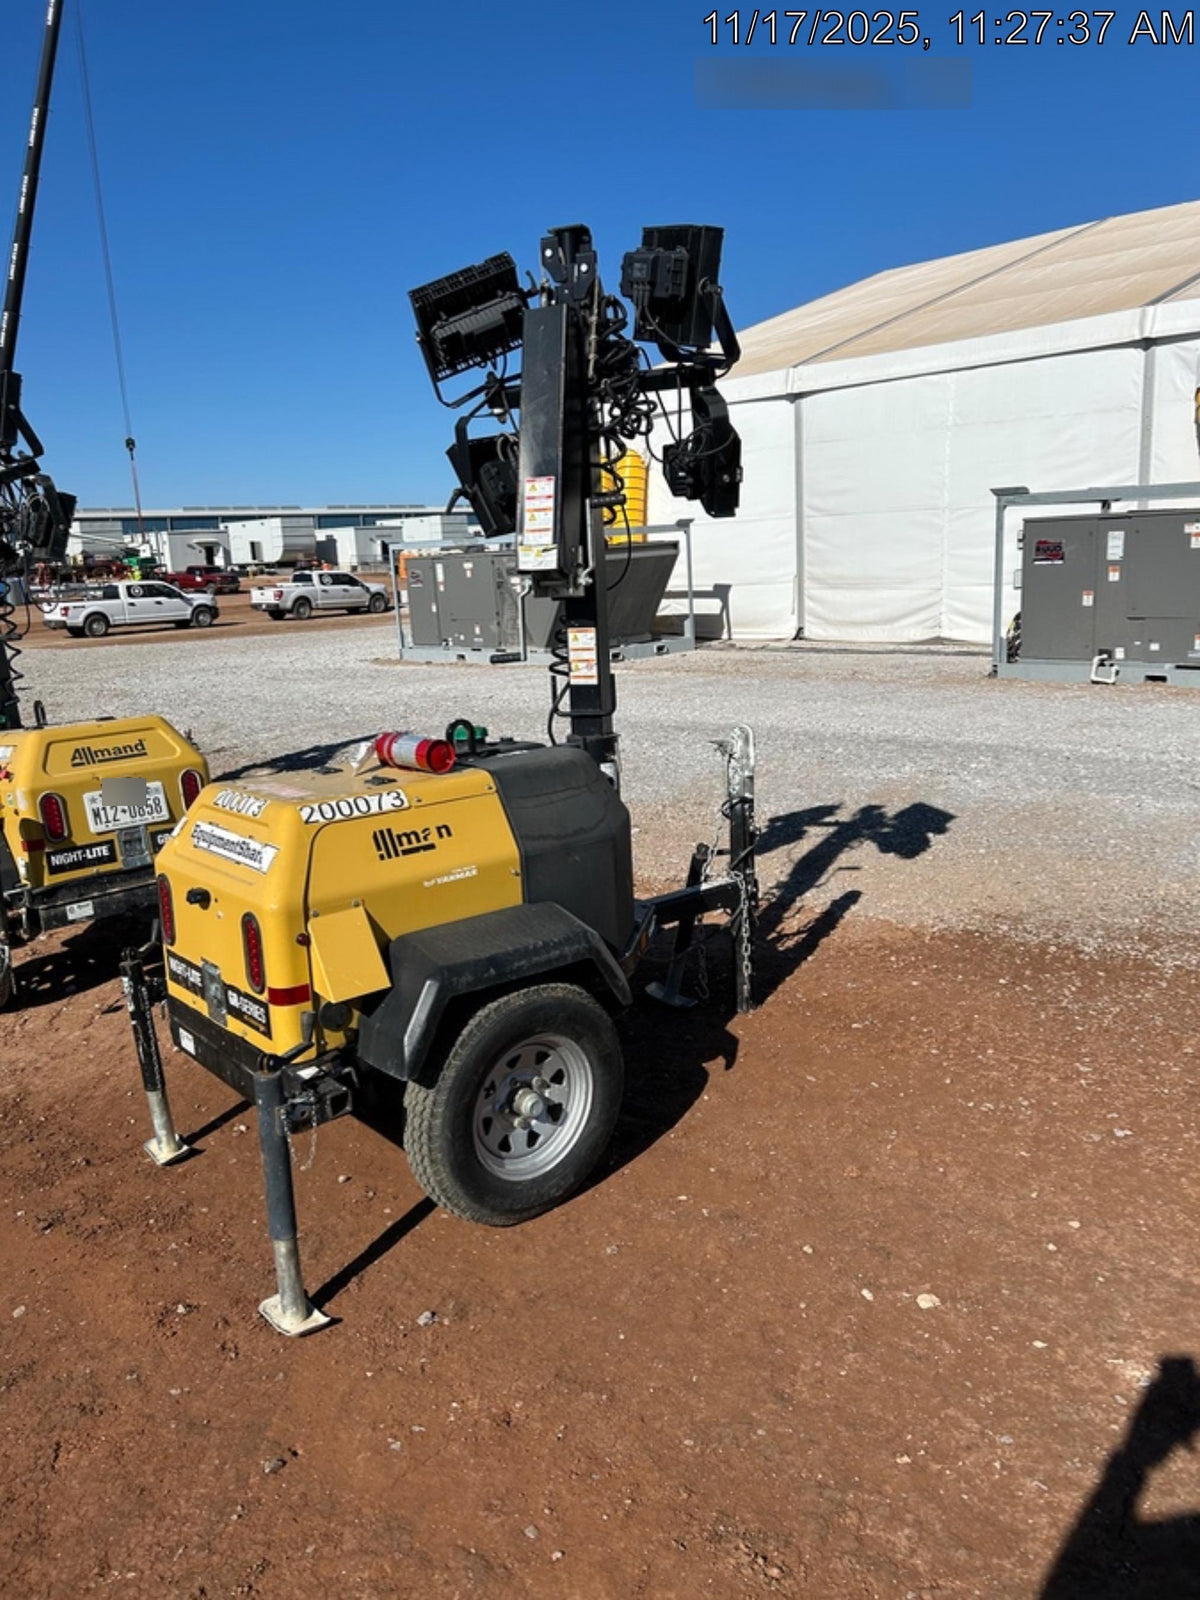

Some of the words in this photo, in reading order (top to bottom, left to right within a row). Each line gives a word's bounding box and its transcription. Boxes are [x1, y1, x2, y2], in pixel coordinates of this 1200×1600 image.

[70, 738, 147, 767] Allmand
[299, 790, 405, 825] 200073
[50, 845, 110, 866] NIGHT-LITE
